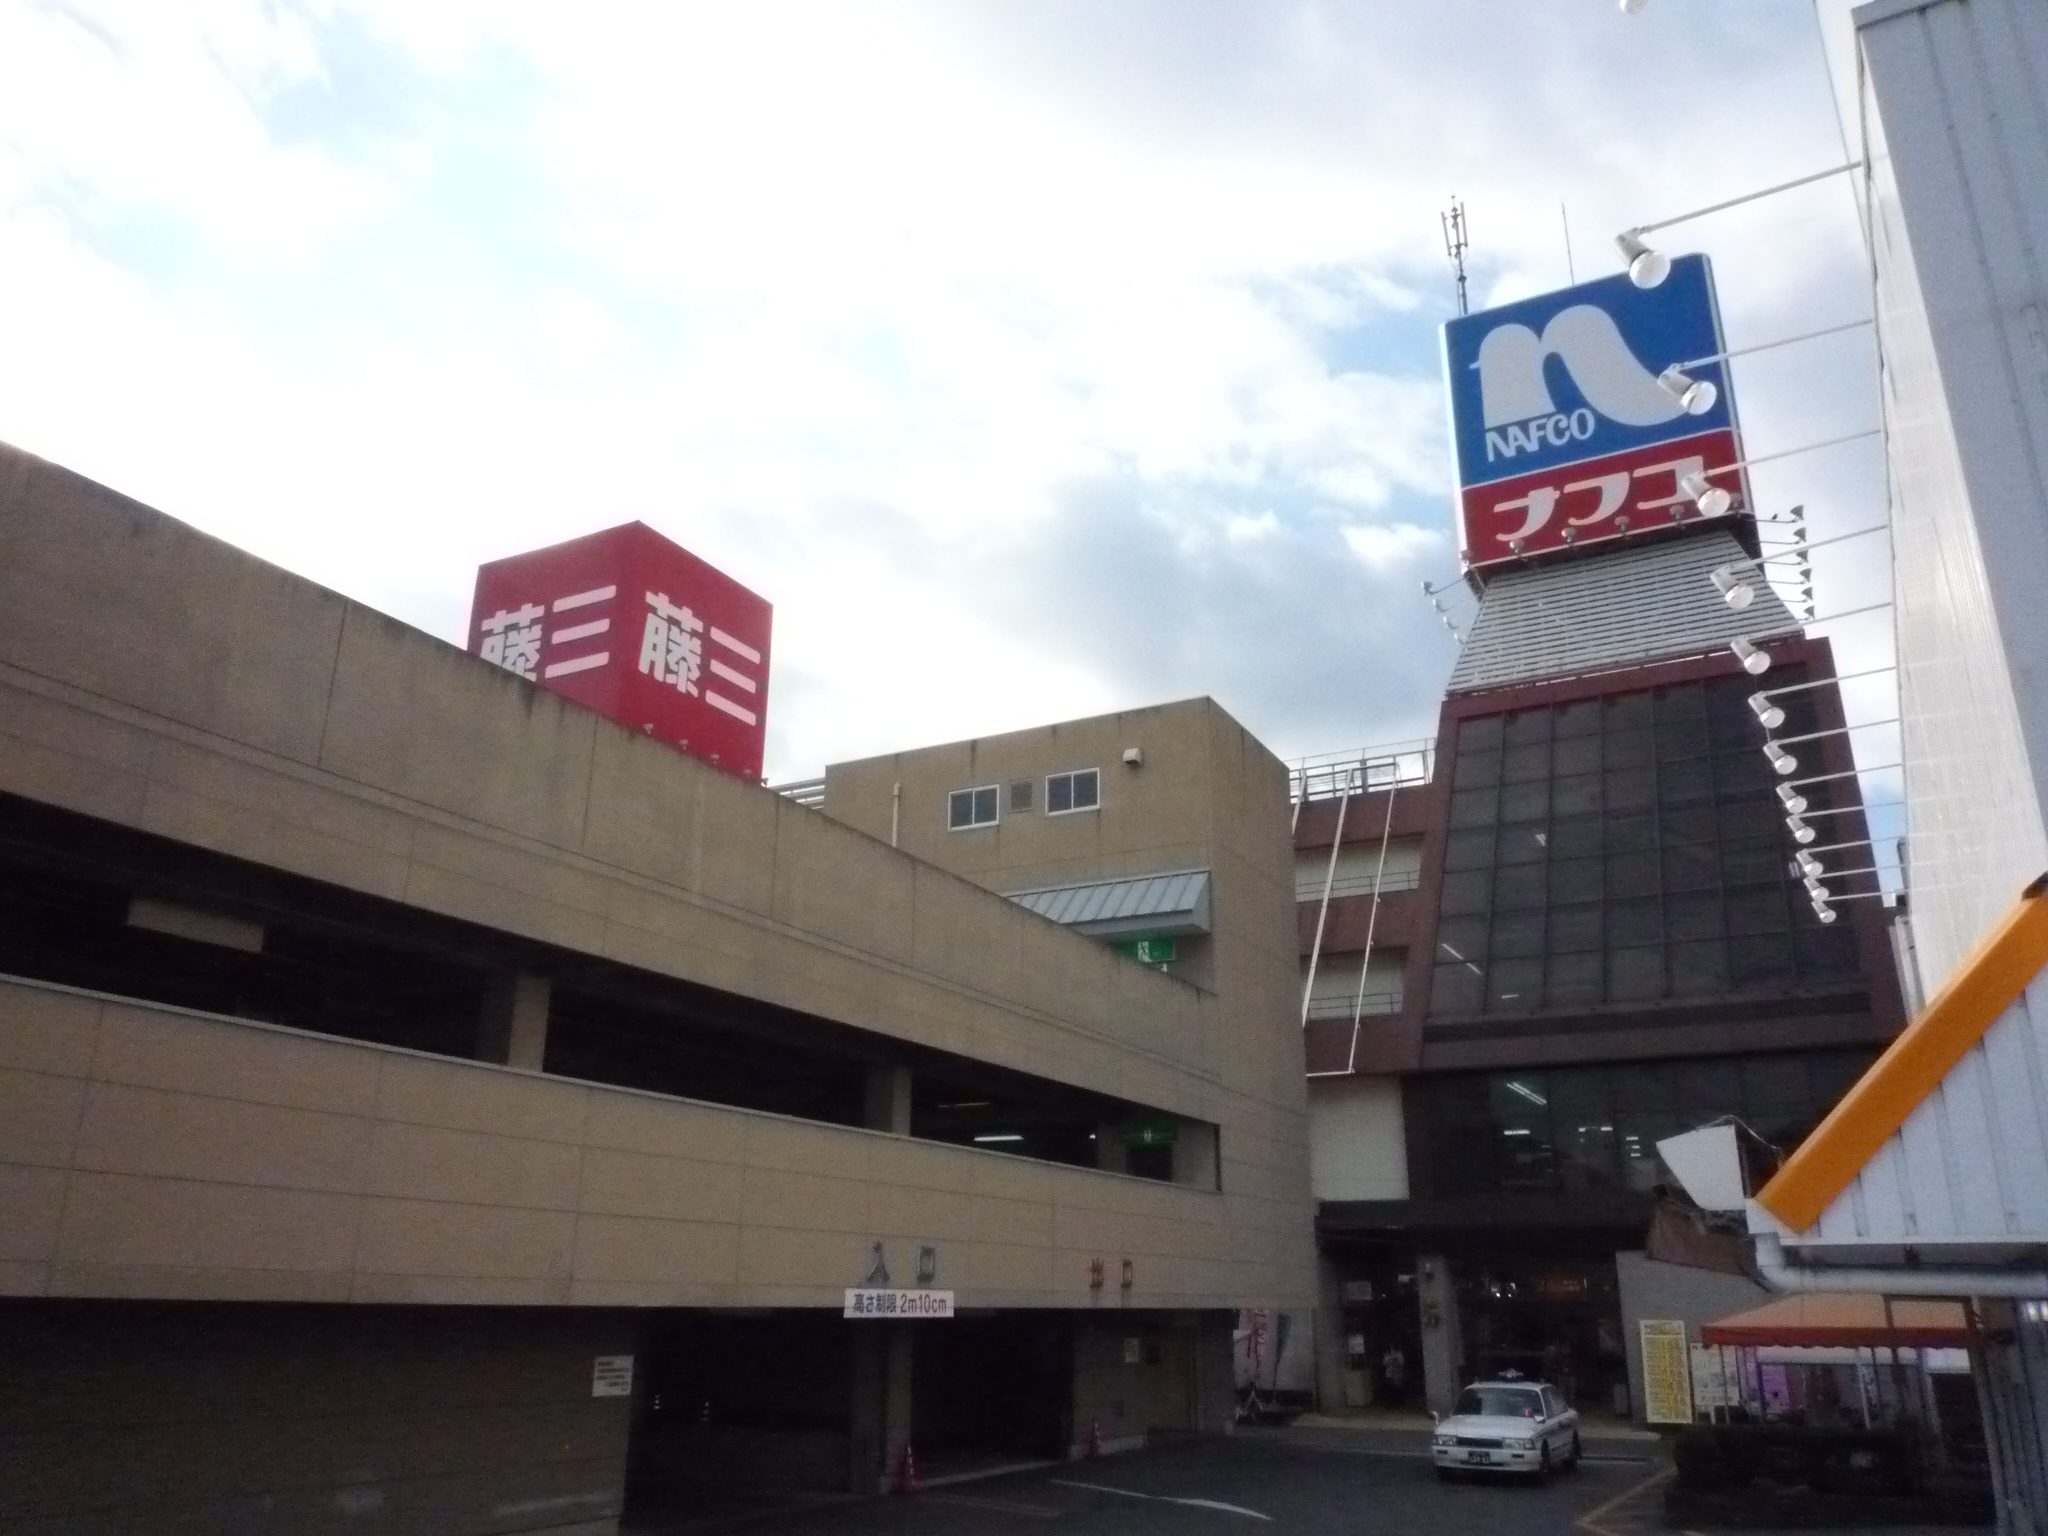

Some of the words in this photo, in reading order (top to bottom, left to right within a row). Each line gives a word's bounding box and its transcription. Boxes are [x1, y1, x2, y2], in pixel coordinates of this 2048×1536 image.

[1486, 410, 1595, 463] NAFCO
[1493, 455, 1704, 541] ナフコ
[480, 585, 617, 682] 藤三
[639, 590, 760, 726] 藤三
[853, 1293, 897, 1314] 高さ制限
[900, 1293, 948, 1314] 2m10cm
